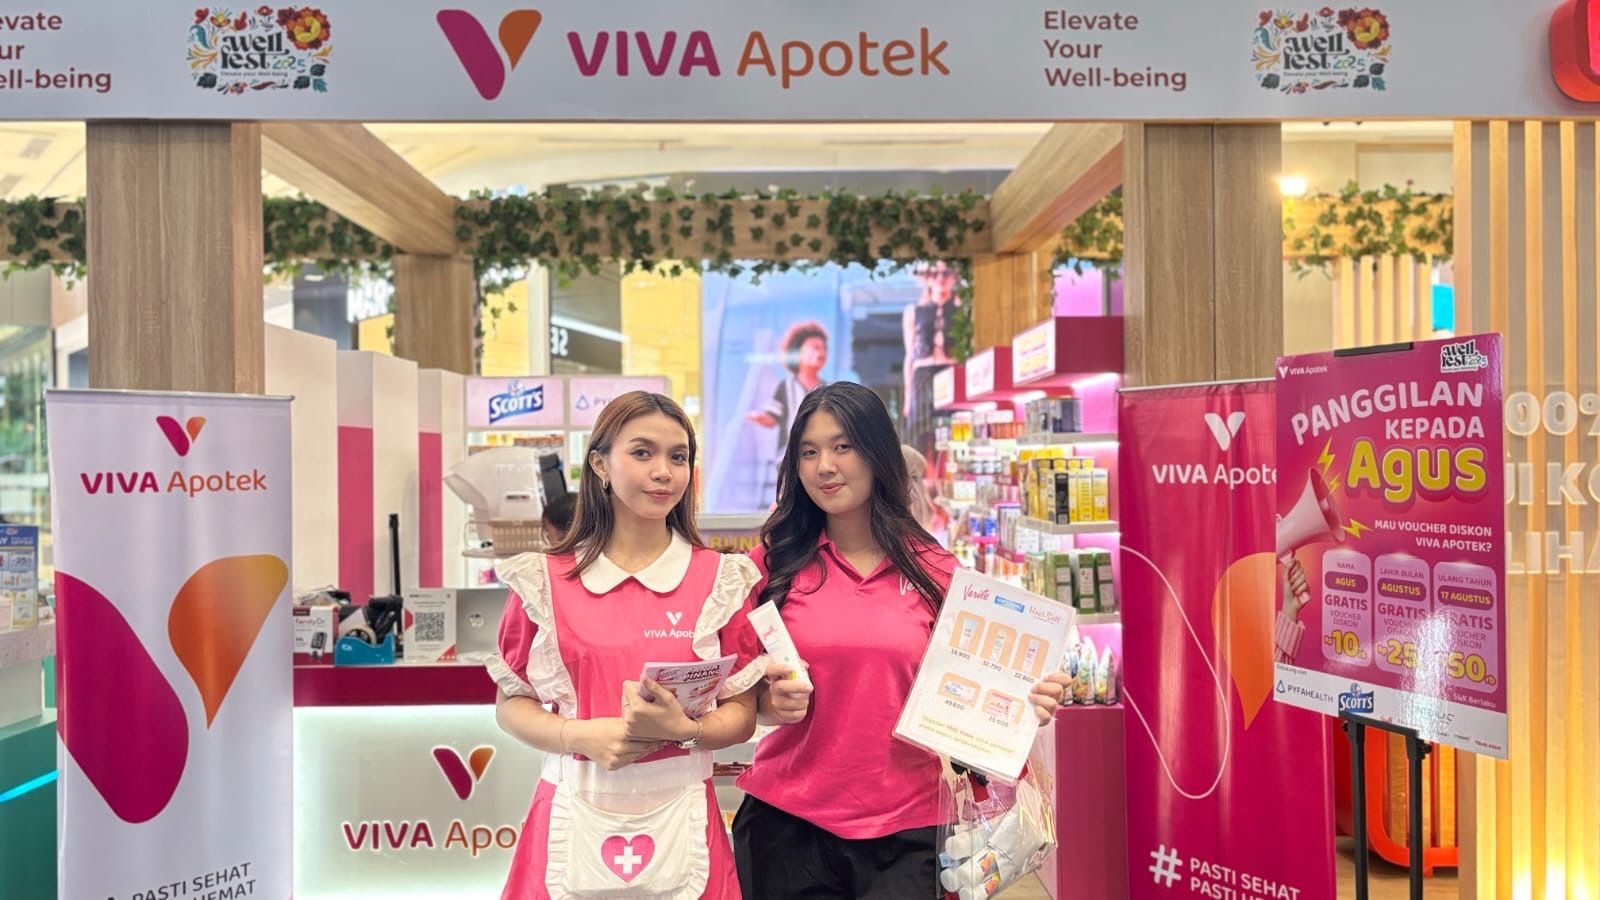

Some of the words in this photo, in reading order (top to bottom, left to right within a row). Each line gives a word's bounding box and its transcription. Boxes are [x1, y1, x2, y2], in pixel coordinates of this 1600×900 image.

[1044, 11, 1139, 30] Elevate
[567, 31, 720, 76] VIVA
[737, 27, 950, 88] Apotek
[1044, 40, 1103, 58] Your
[272, 55, 307, 73] 2025
[1333, 55, 1366, 72] 2025
[1044, 68, 1187, 91] Well-being
[1290, 367, 1304, 376] VIVA
[1305, 364, 1328, 376] Apotek
[1291, 381, 1483, 445] PANGGILAN
[1385, 416, 1485, 439] KEPADA
[1152, 464, 1208, 485] VIVA
[1347, 440, 1487, 503] Agus
[81, 472, 159, 494] VIVA
[167, 469, 267, 497] Apotek
[1375, 520, 1396, 530] MAU
[1398, 521, 1447, 534] VOUCHER
[1449, 525, 1492, 537] DISKON
[1416, 537, 1441, 548] VIVA
[1442, 539, 1493, 552] APOTEK?
[1337, 562, 1355, 570] NAMA
[1380, 568, 1400, 577] LAHIR
[1400, 570, 1424, 580] BULAN
[1335, 577, 1356, 587] AGUS
[1381, 582, 1421, 596] AGUSTUS
[1438, 575, 1464, 584] ULANG
[1465, 577, 1492, 587] TAHUN
[1325, 594, 1368, 611] GRATIS
[1440, 591, 1449, 600] 17
[1450, 593, 1491, 605] AGUSTUS
[1330, 609, 1361, 621] VOUCHER
[1378, 602, 1426, 619] GRATIS
[1333, 618, 1358, 628] DISKON
[643, 629, 668, 639] VIVA
[1288, 684, 1333, 702] PYFAHEALTH
[343, 822, 434, 849] VIVA
[192, 862, 251, 892] SEHAT
[1190, 857, 1236, 885] PASTI
[1241, 872, 1300, 900] SEHAT
